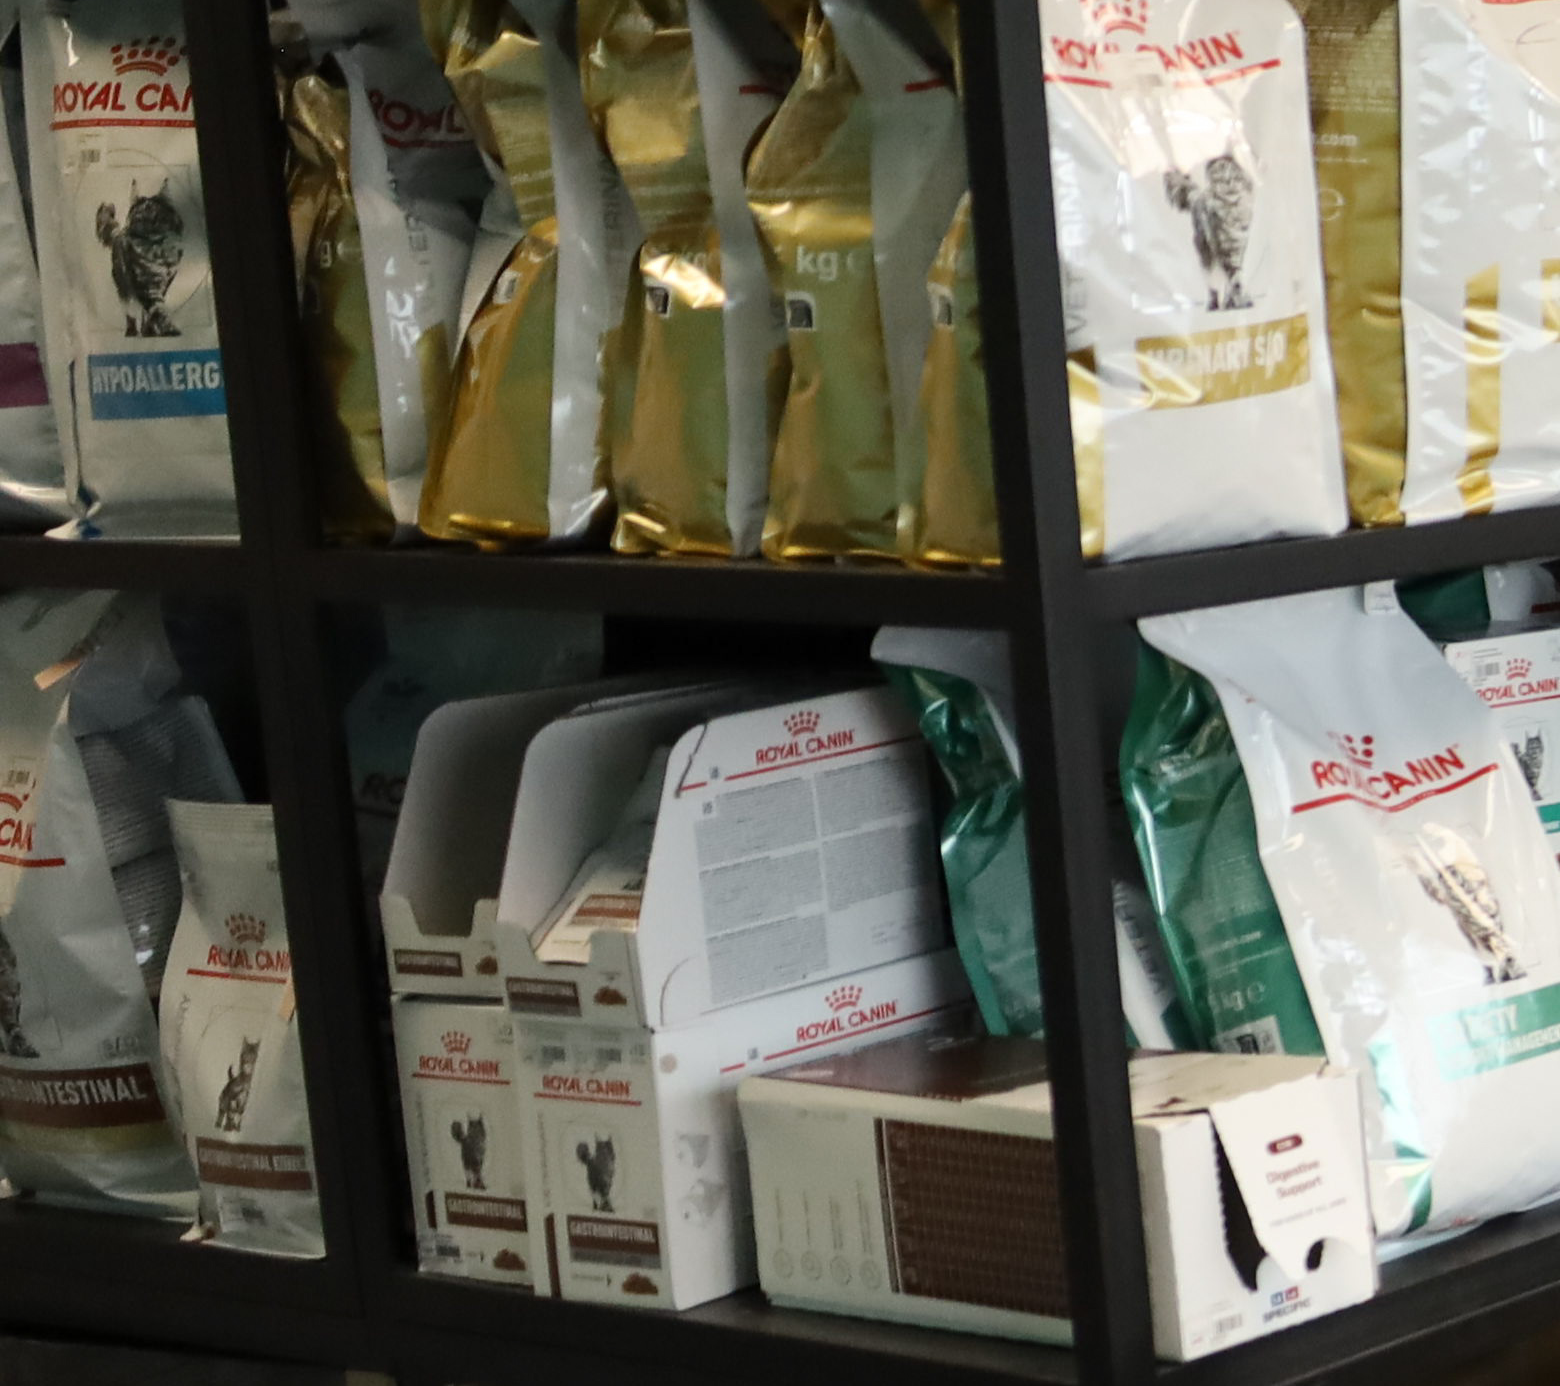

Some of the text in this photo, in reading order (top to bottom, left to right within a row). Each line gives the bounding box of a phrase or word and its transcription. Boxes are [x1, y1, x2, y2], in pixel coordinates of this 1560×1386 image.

[53, 81, 127, 114] ROYAL
[795, 247, 838, 282] kg
[91, 362, 223, 396] HYPOALLERG
[1518, 676, 1560, 696] CANIN
[754, 729, 855, 764] ROYAL CANIN
[1370, 746, 1467, 801] CANIN
[796, 1002, 898, 1043] ROYAL CANIN
[419, 1055, 499, 1077] ROYAL CANIN
[542, 1075, 632, 1097] ROYAL CANIN
[1265, 1160, 1321, 1185] Digestive
[1277, 1175, 1323, 1200] Support
[1262, 1297, 1312, 1323] SPECIFIC
